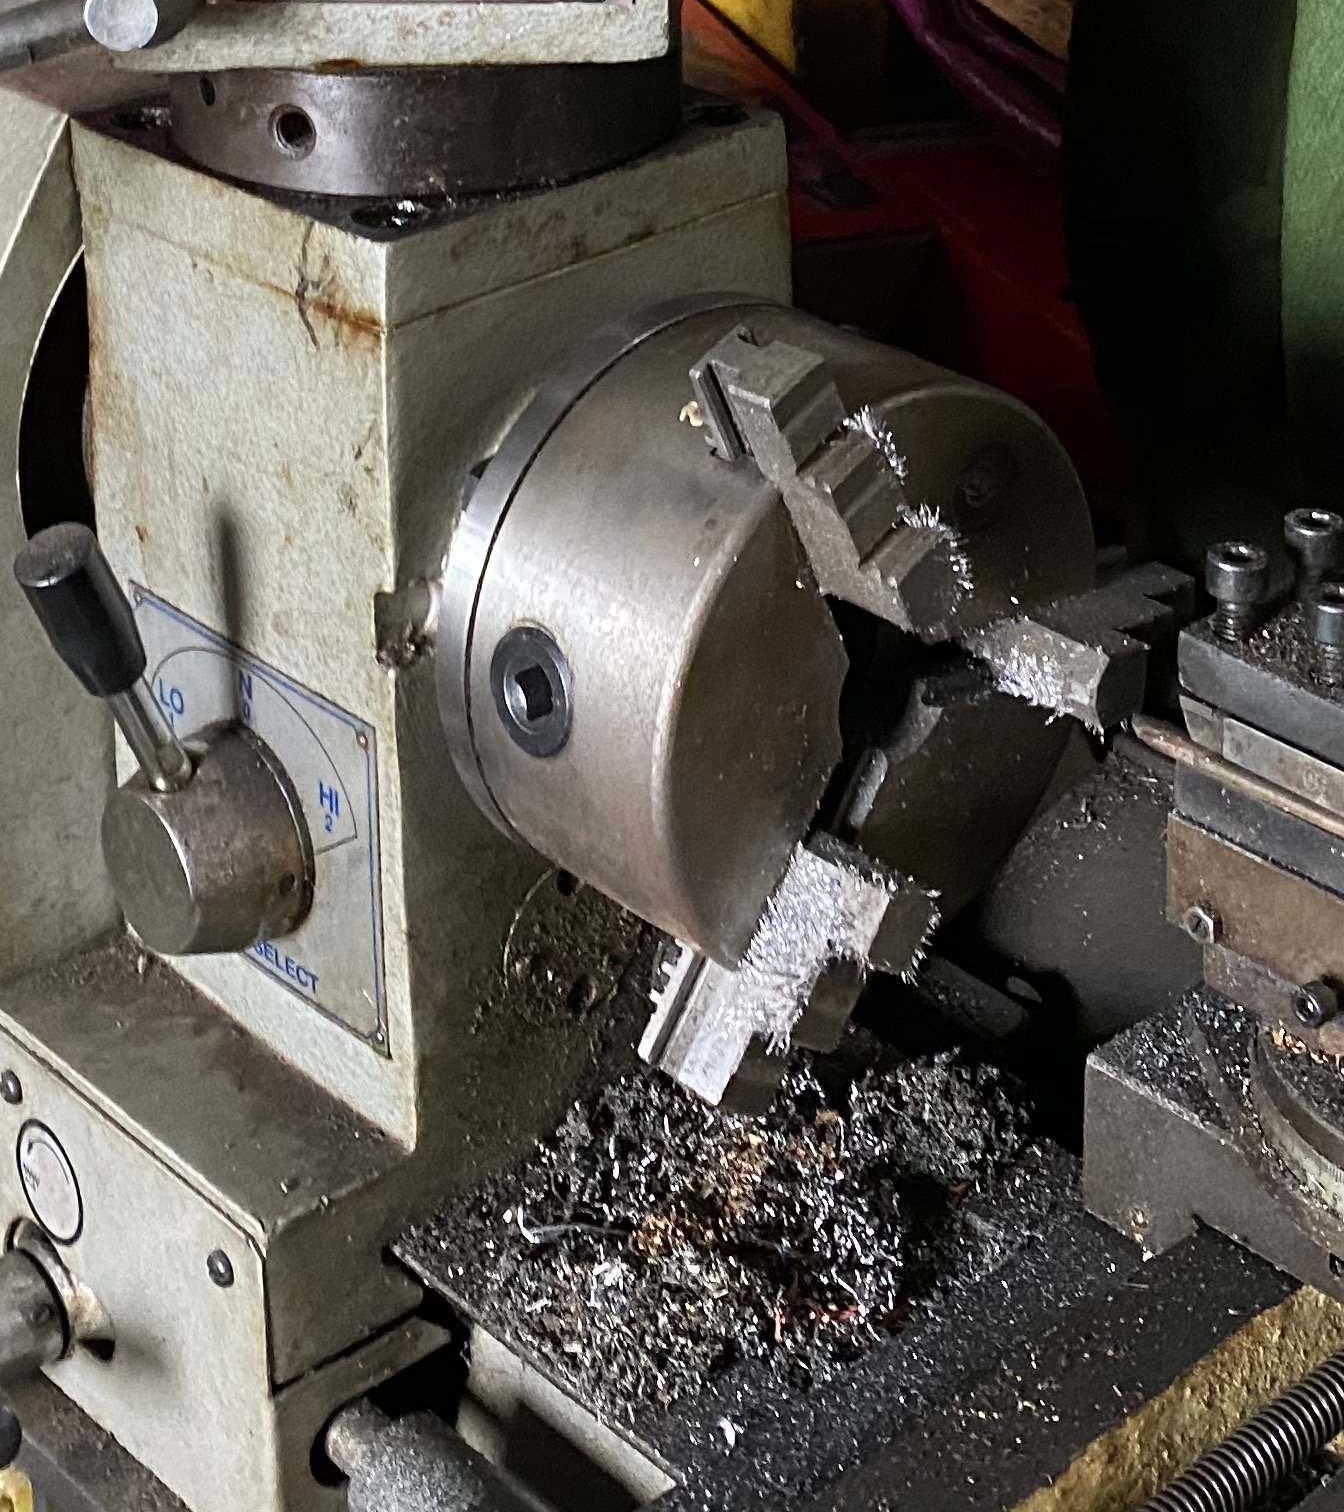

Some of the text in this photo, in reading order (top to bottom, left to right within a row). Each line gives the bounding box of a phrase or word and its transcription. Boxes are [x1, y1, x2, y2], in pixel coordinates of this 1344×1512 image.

[159, 677, 184, 716] LO
[238, 667, 253, 701] N
[319, 780, 339, 817] HI
[324, 813, 334, 833] 2
